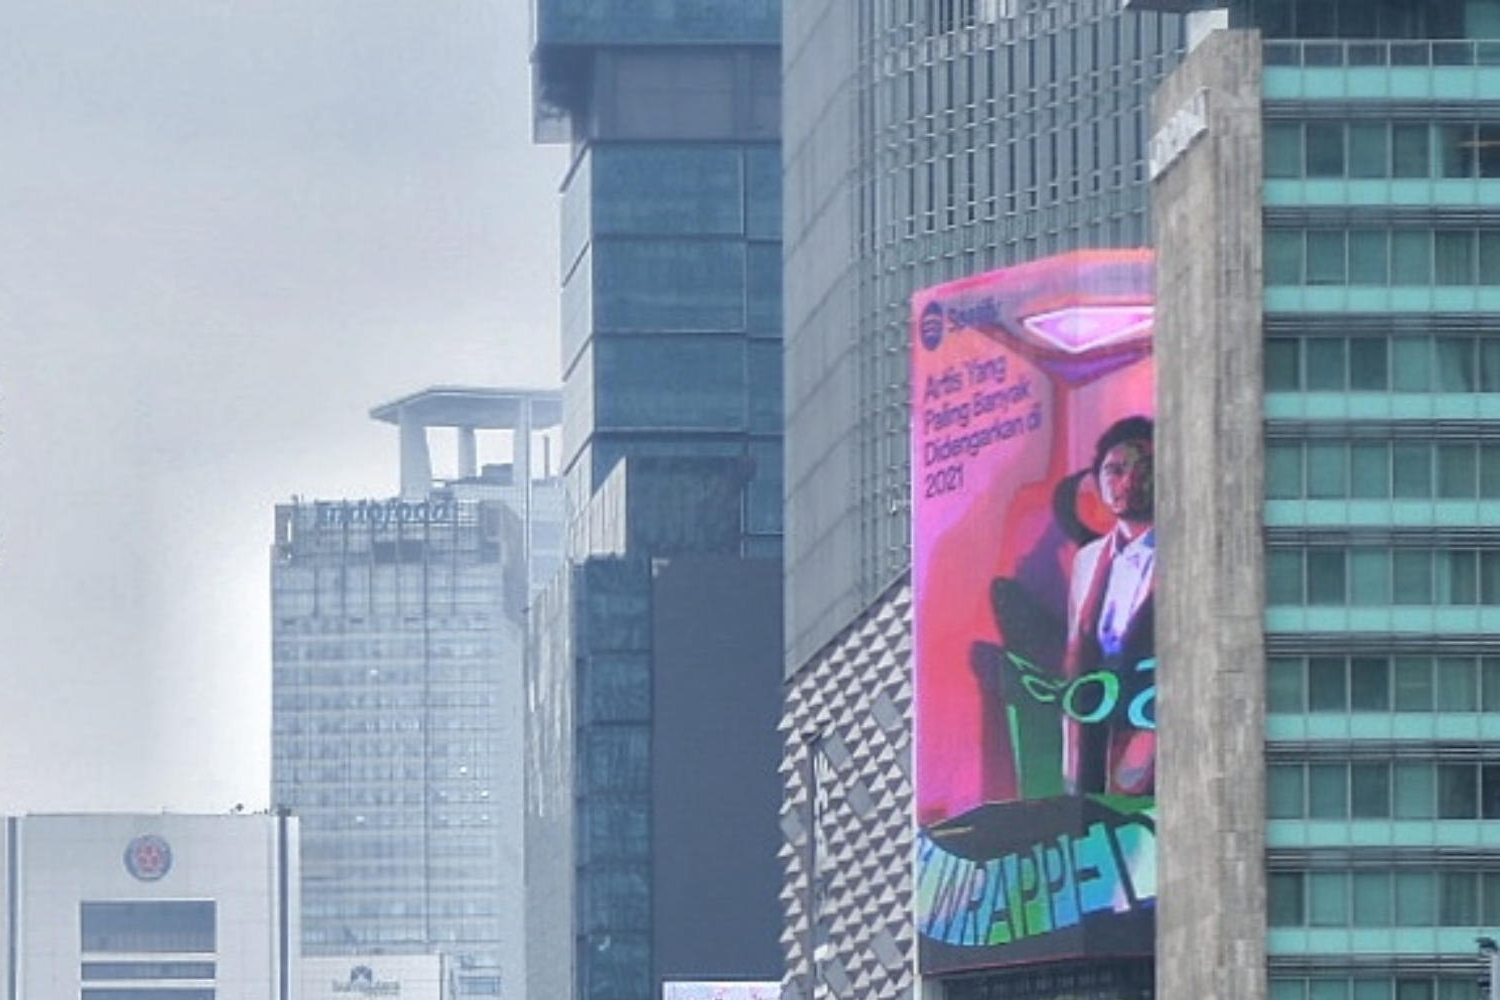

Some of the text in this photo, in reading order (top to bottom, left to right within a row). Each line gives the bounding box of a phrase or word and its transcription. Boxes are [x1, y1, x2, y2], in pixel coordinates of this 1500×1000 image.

[924, 356, 1006, 403] Artis Yang
[924, 378, 1030, 434] Paling Banyak
[925, 463, 964, 499] 2021
